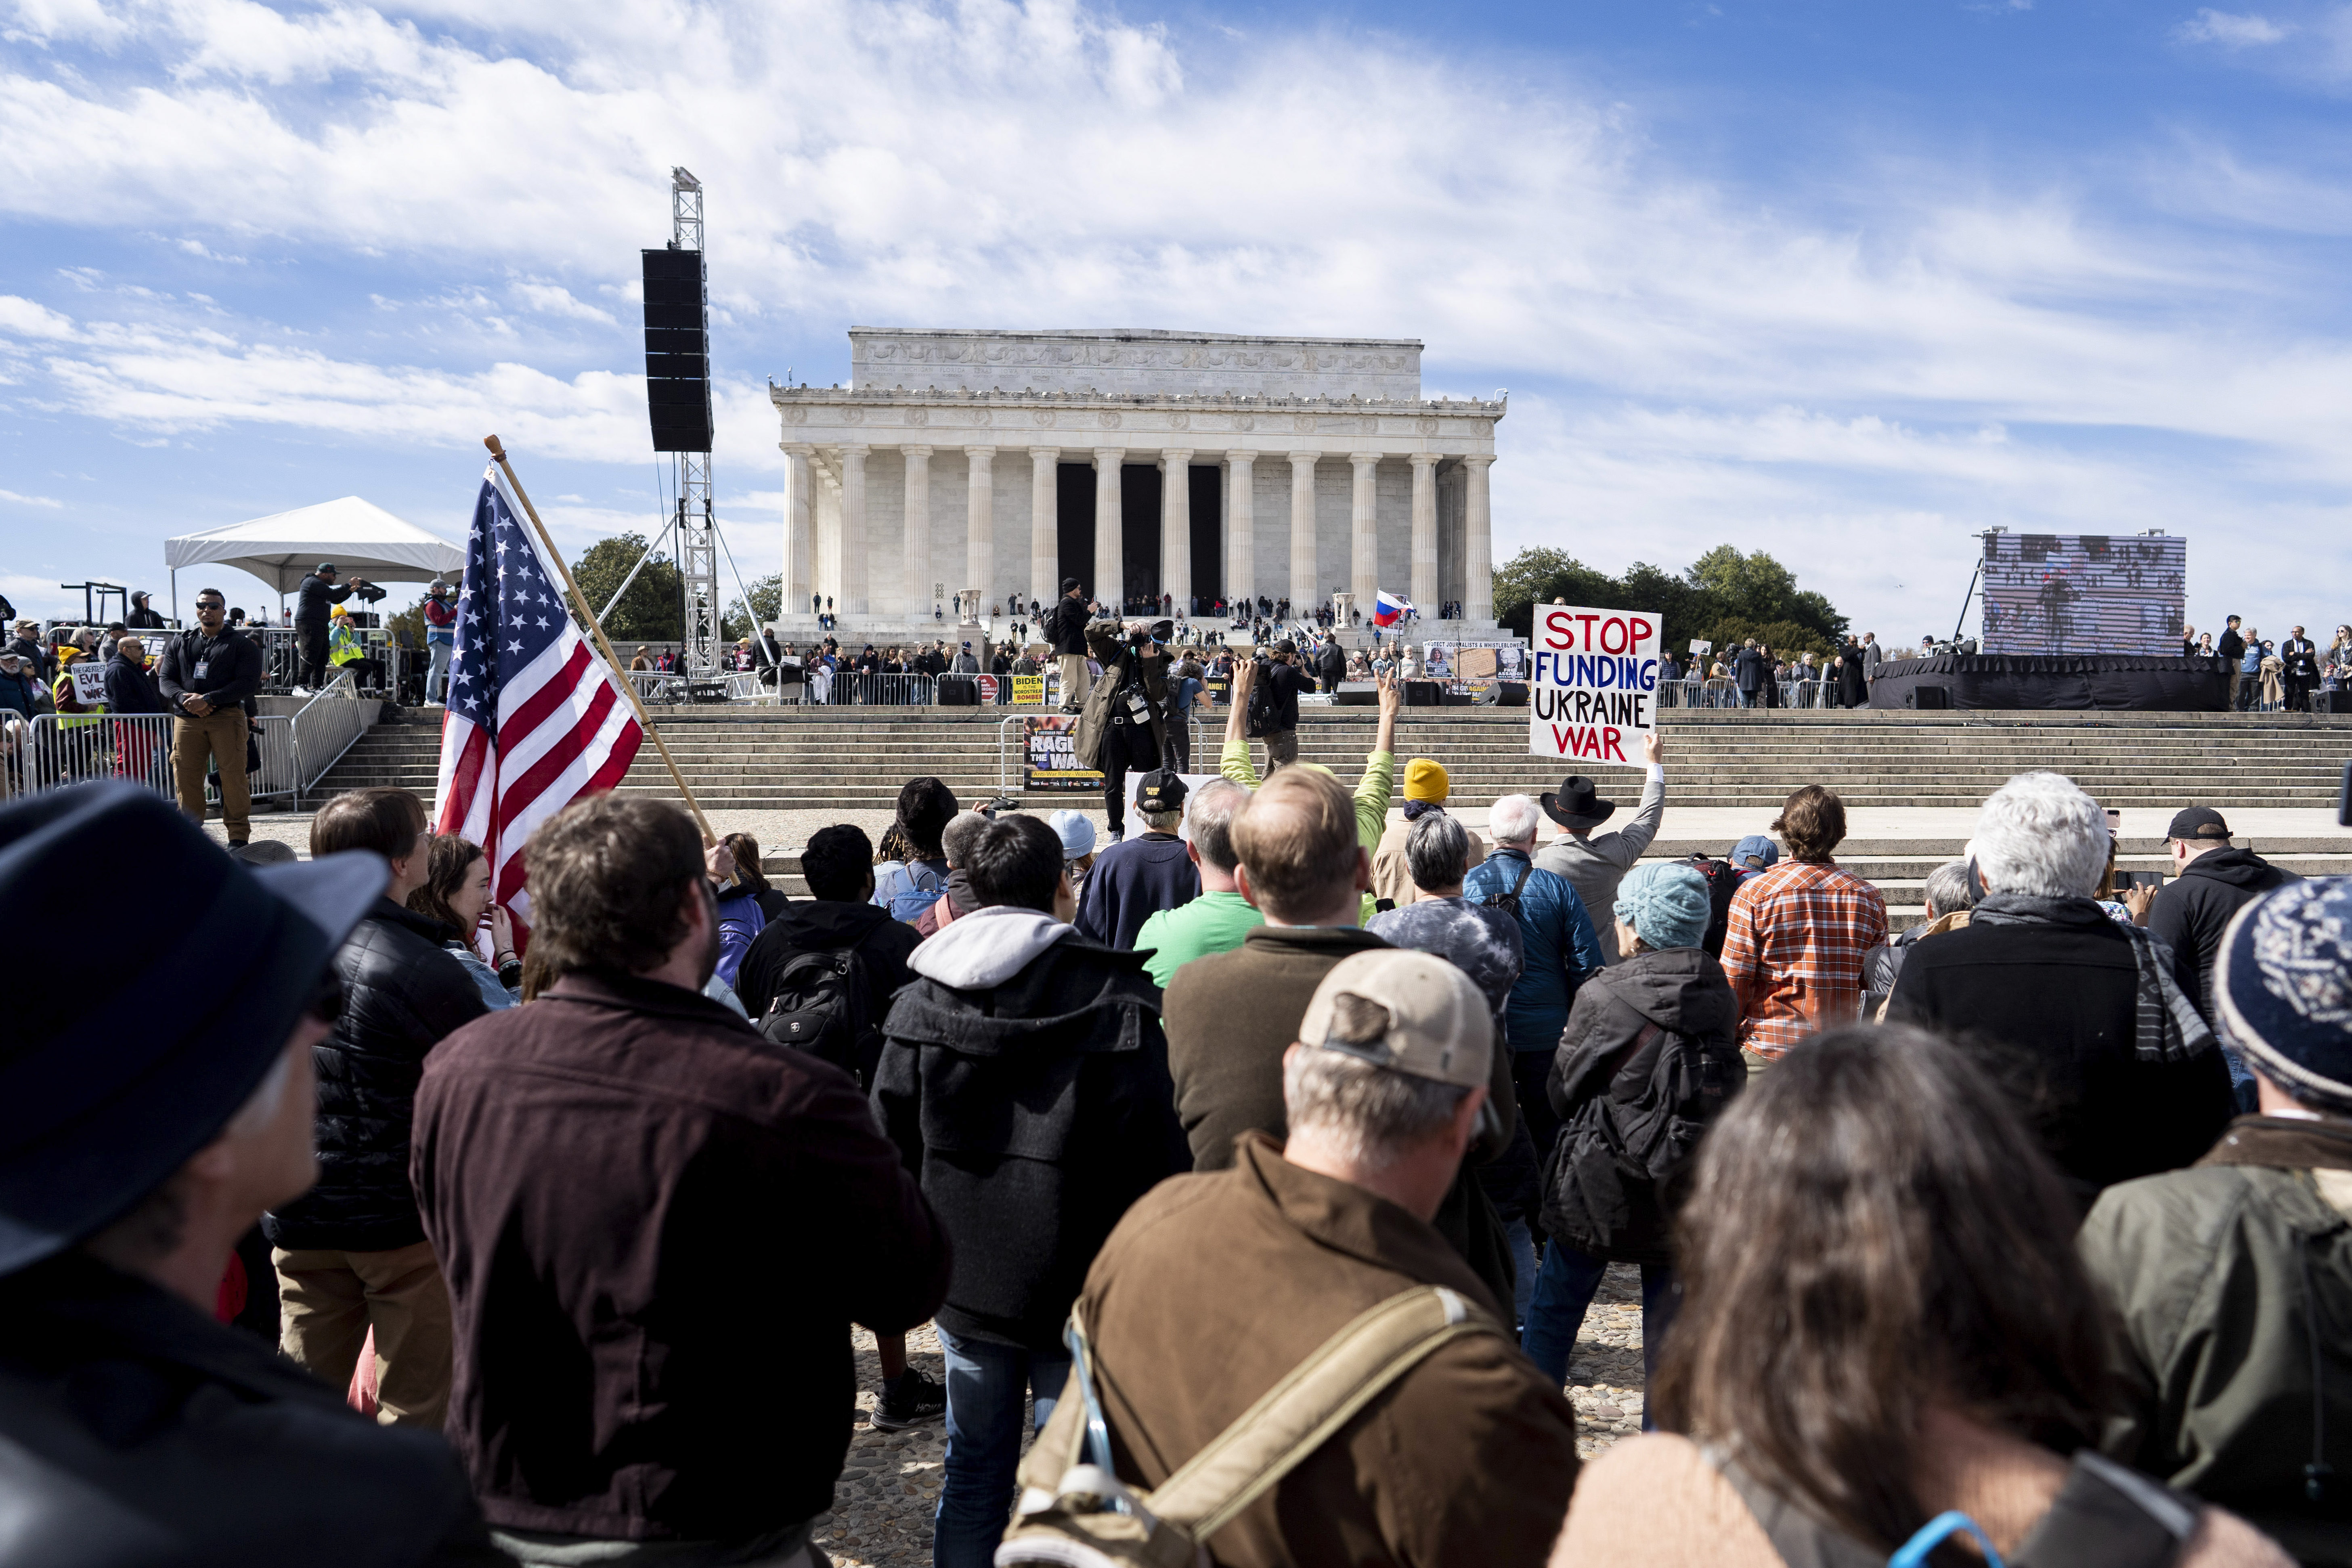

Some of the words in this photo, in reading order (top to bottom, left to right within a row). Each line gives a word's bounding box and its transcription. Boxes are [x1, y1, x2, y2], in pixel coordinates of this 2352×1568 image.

[140, 639, 166, 655] GE
[1545, 612, 1652, 655] STOP
[73, 666, 82, 674] THE
[82, 665, 105, 673] GREATEST
[79, 673, 104, 685] EVIL
[1535, 652, 1657, 691] FUNDING
[82, 687, 107, 700] WAR
[1535, 688, 1650, 729] UKRAINE
[1551, 724, 1627, 762] WAR
